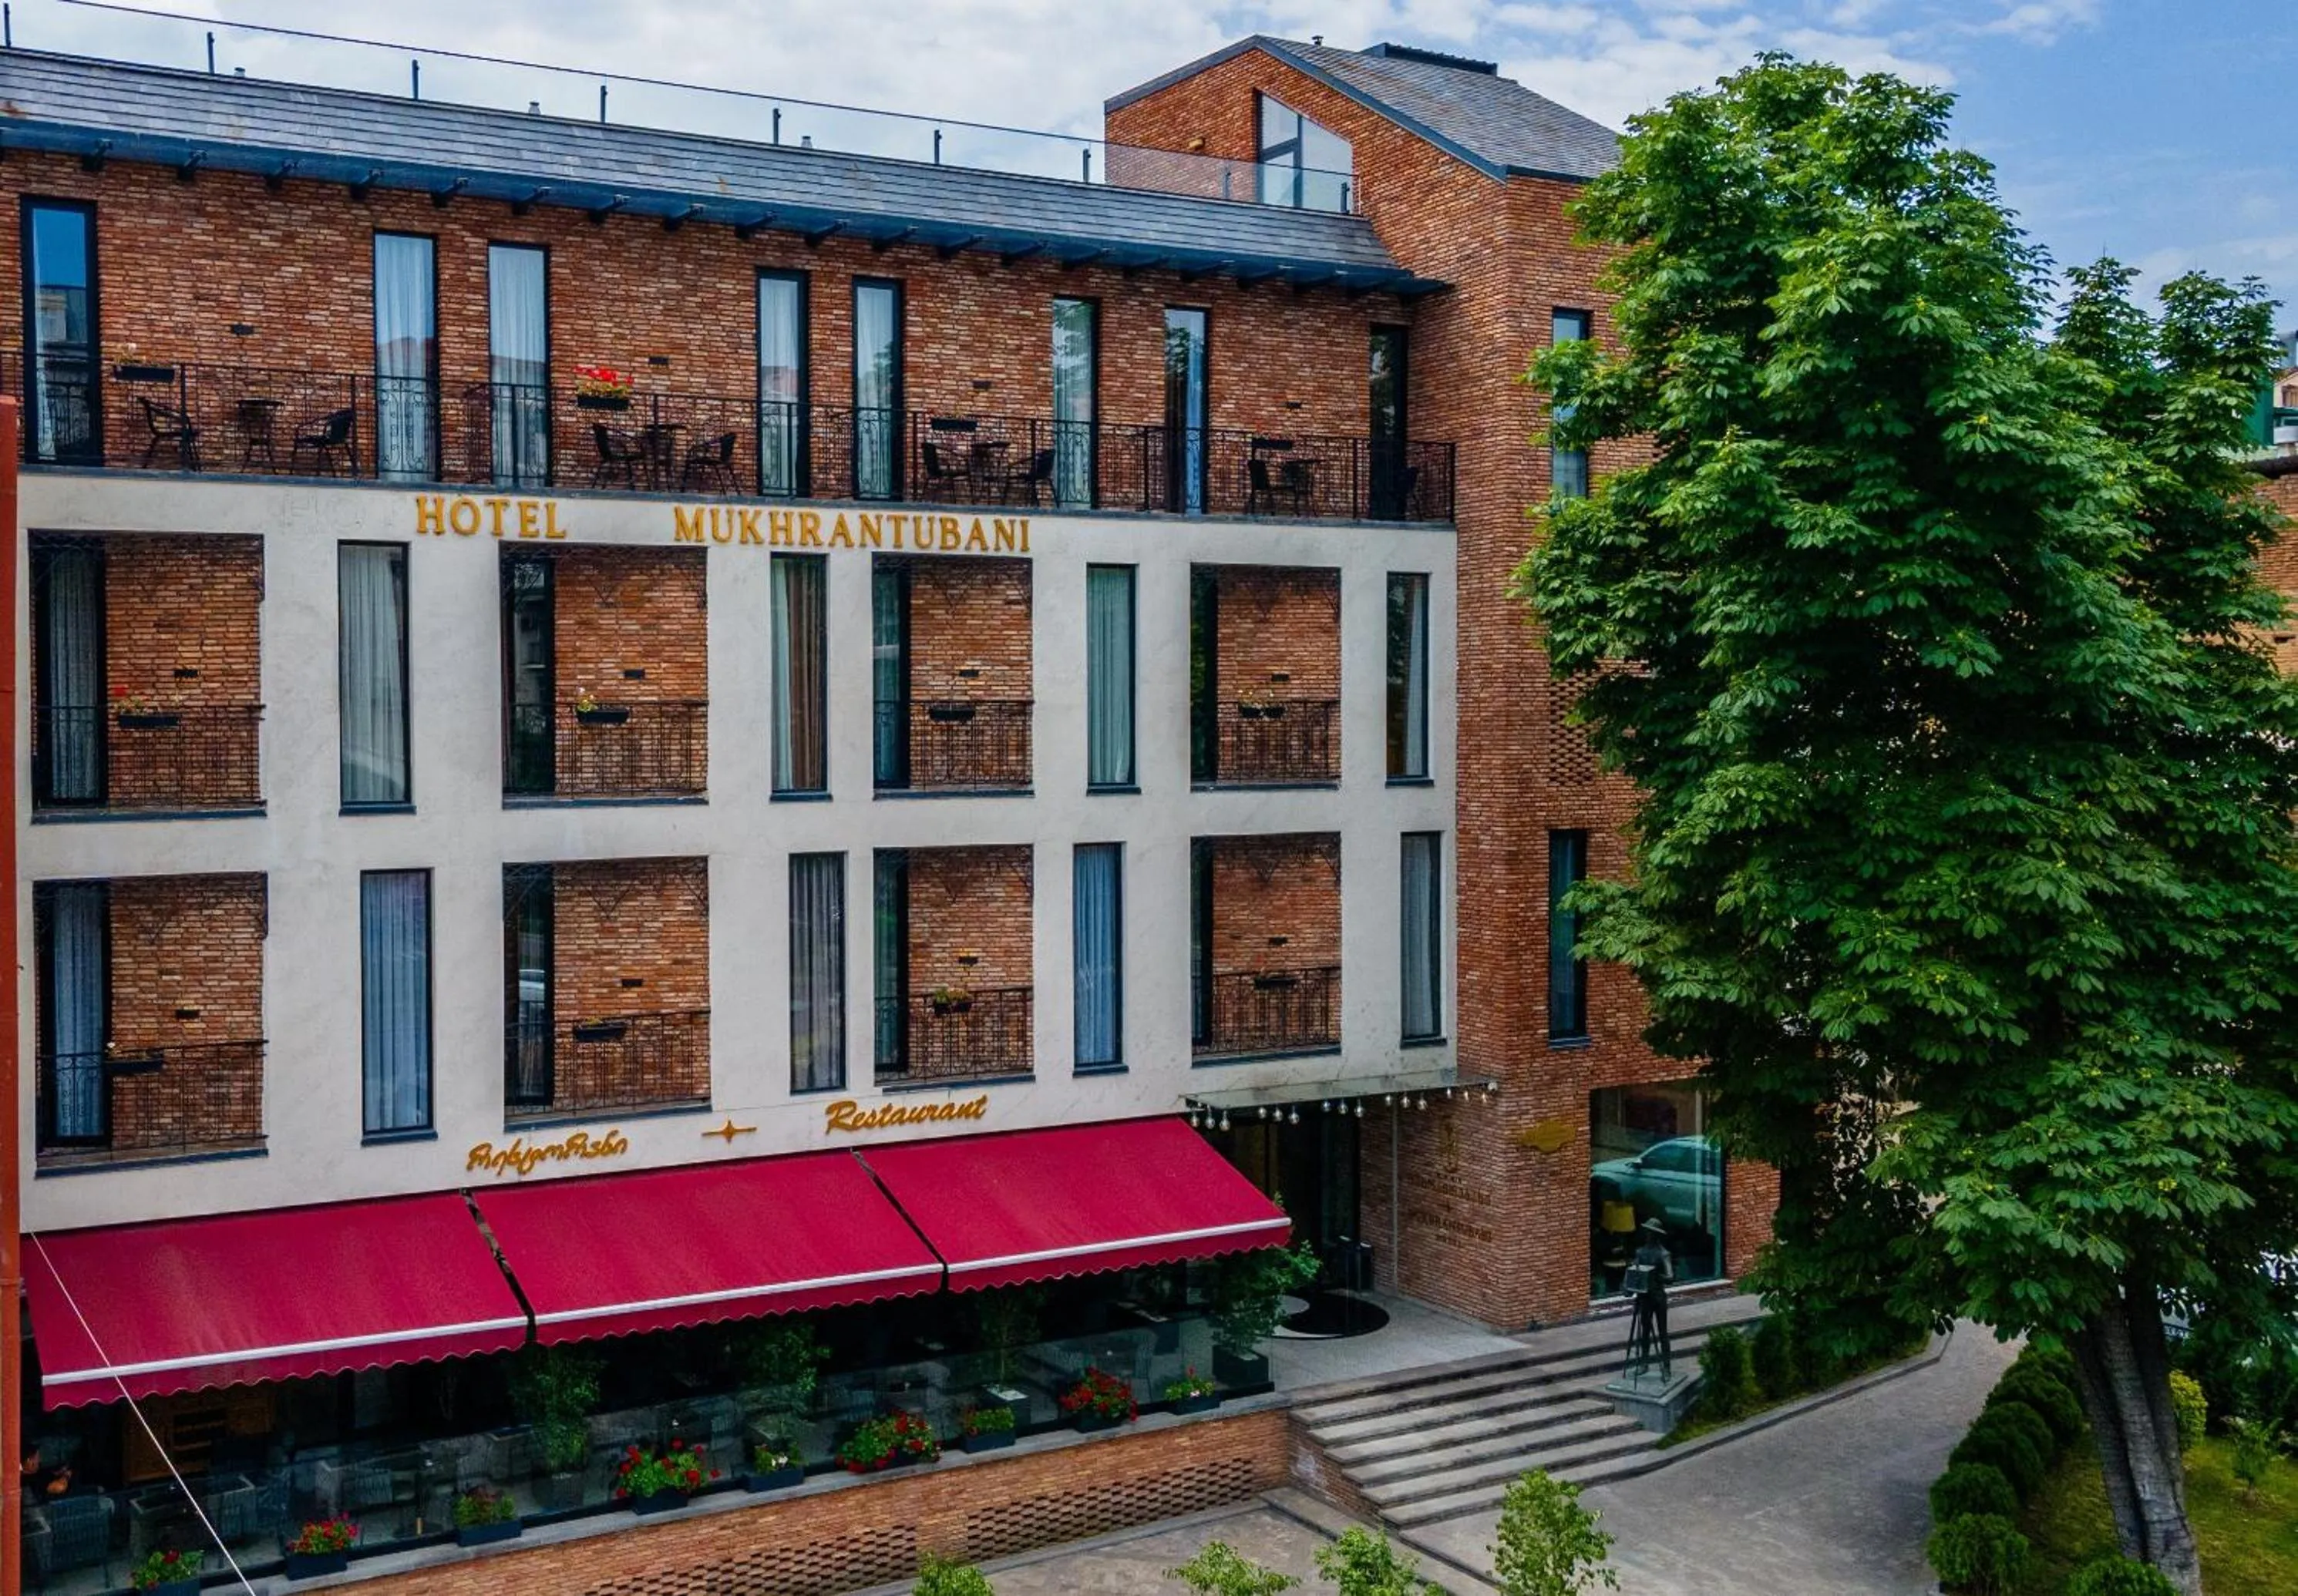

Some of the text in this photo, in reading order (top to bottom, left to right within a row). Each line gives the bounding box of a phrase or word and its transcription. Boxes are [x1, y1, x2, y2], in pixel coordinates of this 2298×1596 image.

[416, 495, 567, 536] HOTEL
[674, 506, 1030, 553] MUKHRANTUBANI
[825, 1094, 988, 1135] Restaurant
